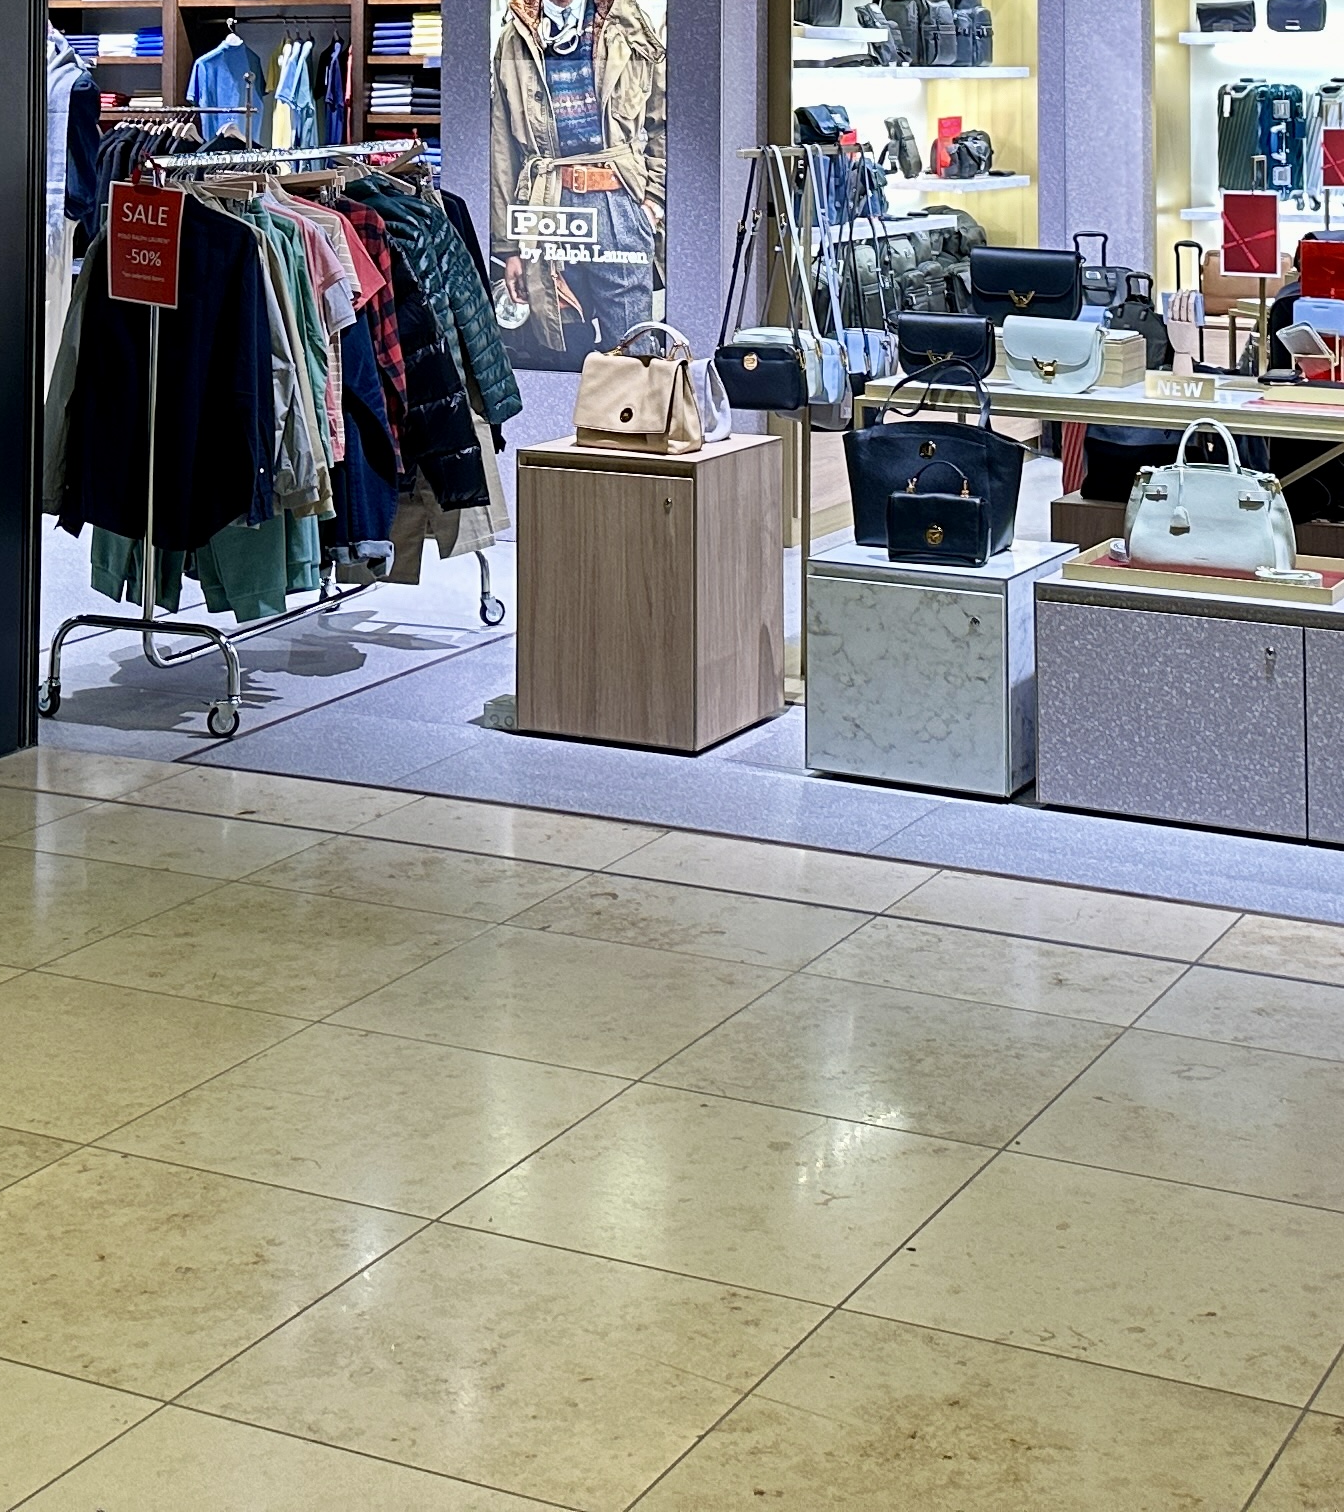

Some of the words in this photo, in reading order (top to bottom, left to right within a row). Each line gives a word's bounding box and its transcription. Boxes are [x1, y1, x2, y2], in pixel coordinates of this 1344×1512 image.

[121, 202, 169, 226] SALE
[514, 212, 588, 235] Polo
[125, 249, 161, 266] -50%
[519, 240, 541, 263] by
[544, 243, 590, 264] Ralph
[592, 245, 649, 264] Lauren
[1158, 379, 1203, 397] NEW
